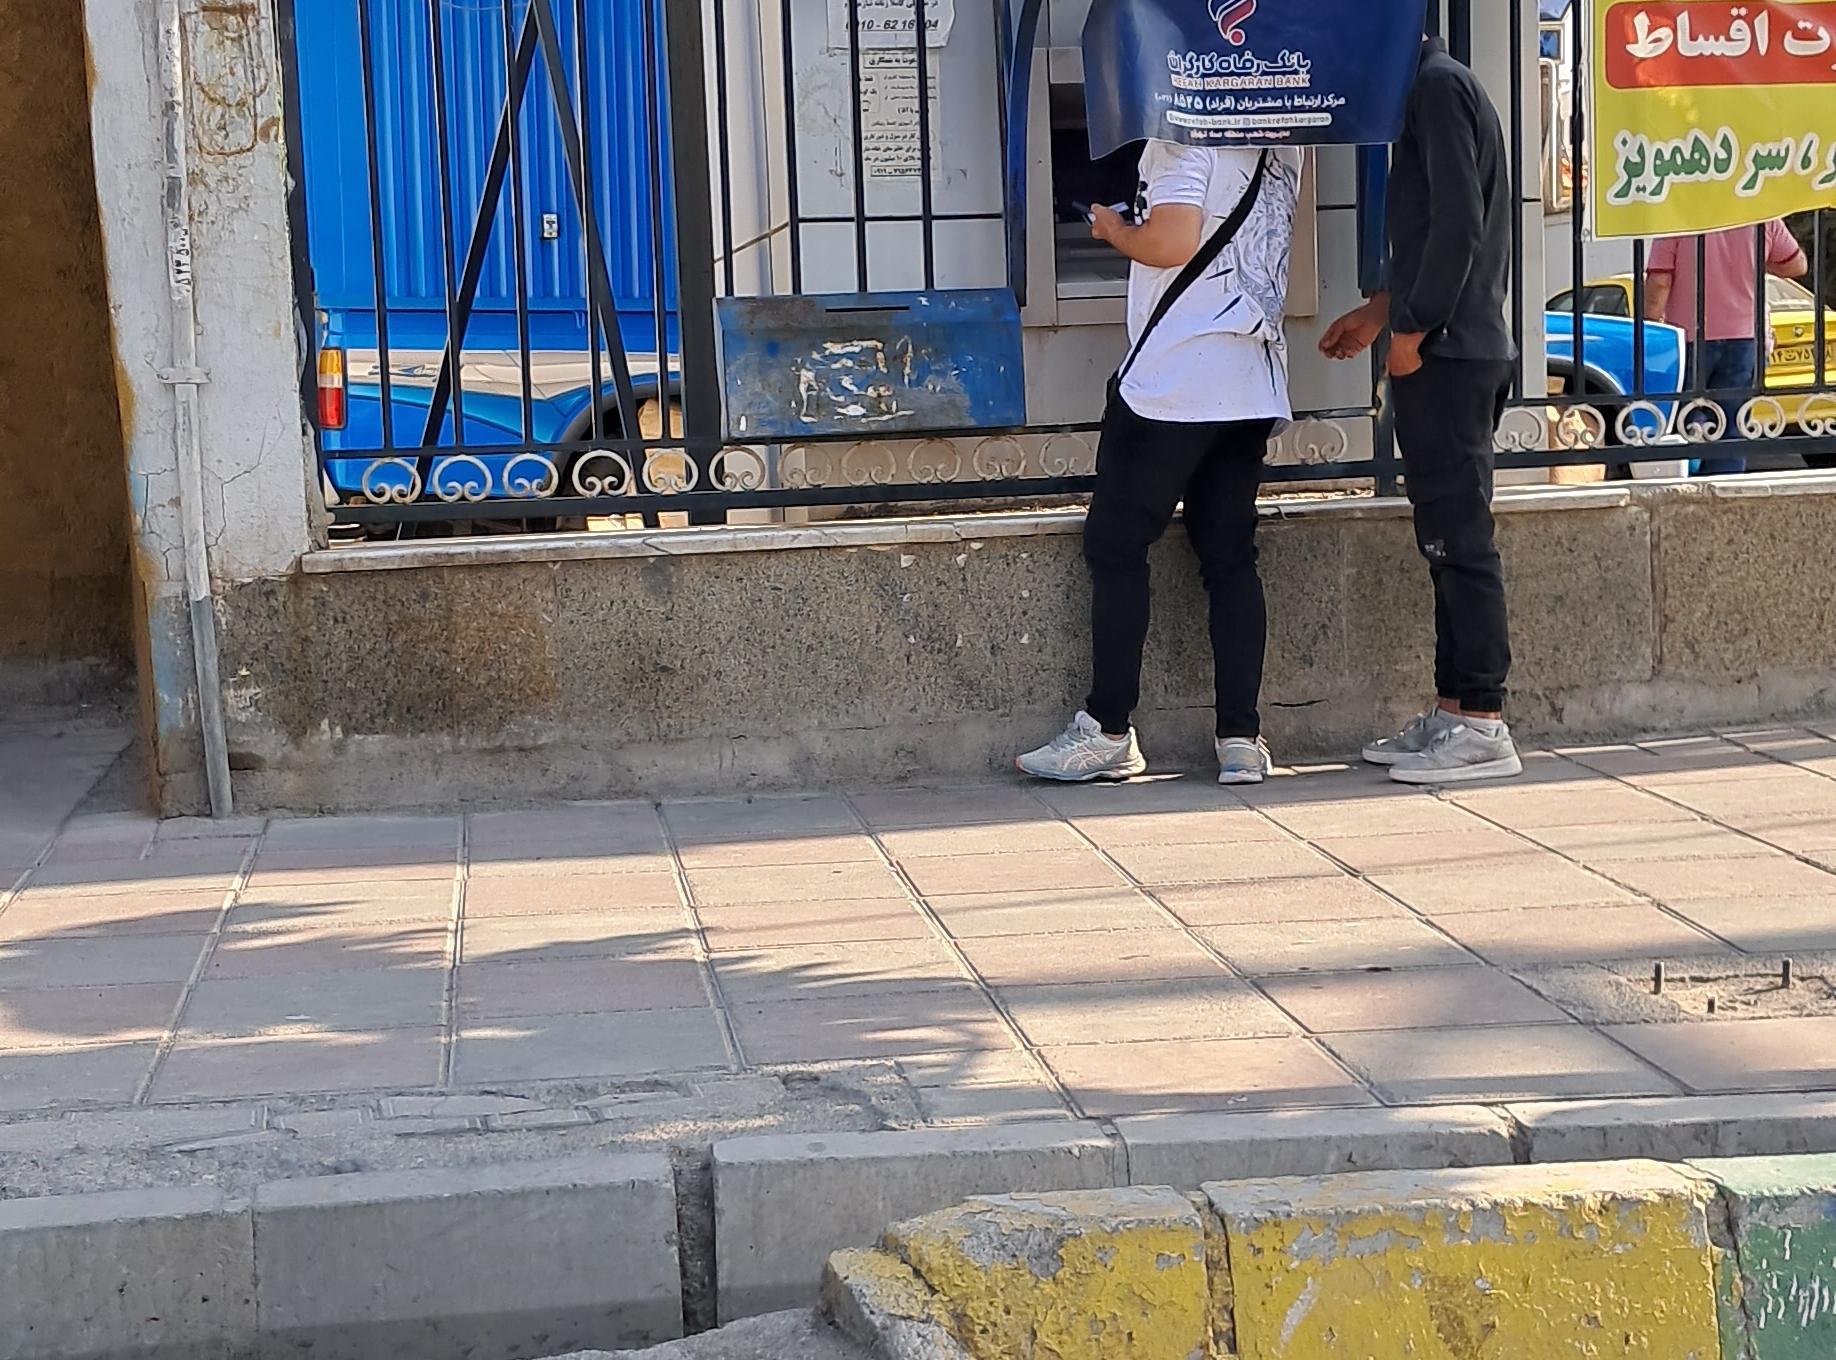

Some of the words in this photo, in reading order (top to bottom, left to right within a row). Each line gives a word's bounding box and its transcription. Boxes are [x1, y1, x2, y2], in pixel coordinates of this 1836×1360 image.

[883, 19, 898, 30] 62
[1625, 7, 1769, 58] اقساط
[1167, 50, 1217, 77] کارگران
[1216, 51, 1262, 74] رفاه
[1262, 49, 1312, 76] بانک
[1205, 75, 1274, 89] KARGARAN
[1276, 74, 1310, 87] BANK
[1236, 96, 1283, 111] مشتریان
[1283, 94, 1292, 110] با
[1293, 94, 1322, 109] ارتباط
[1322, 92, 1346, 108] مرکز
[1742, 145, 1790, 191] سر
